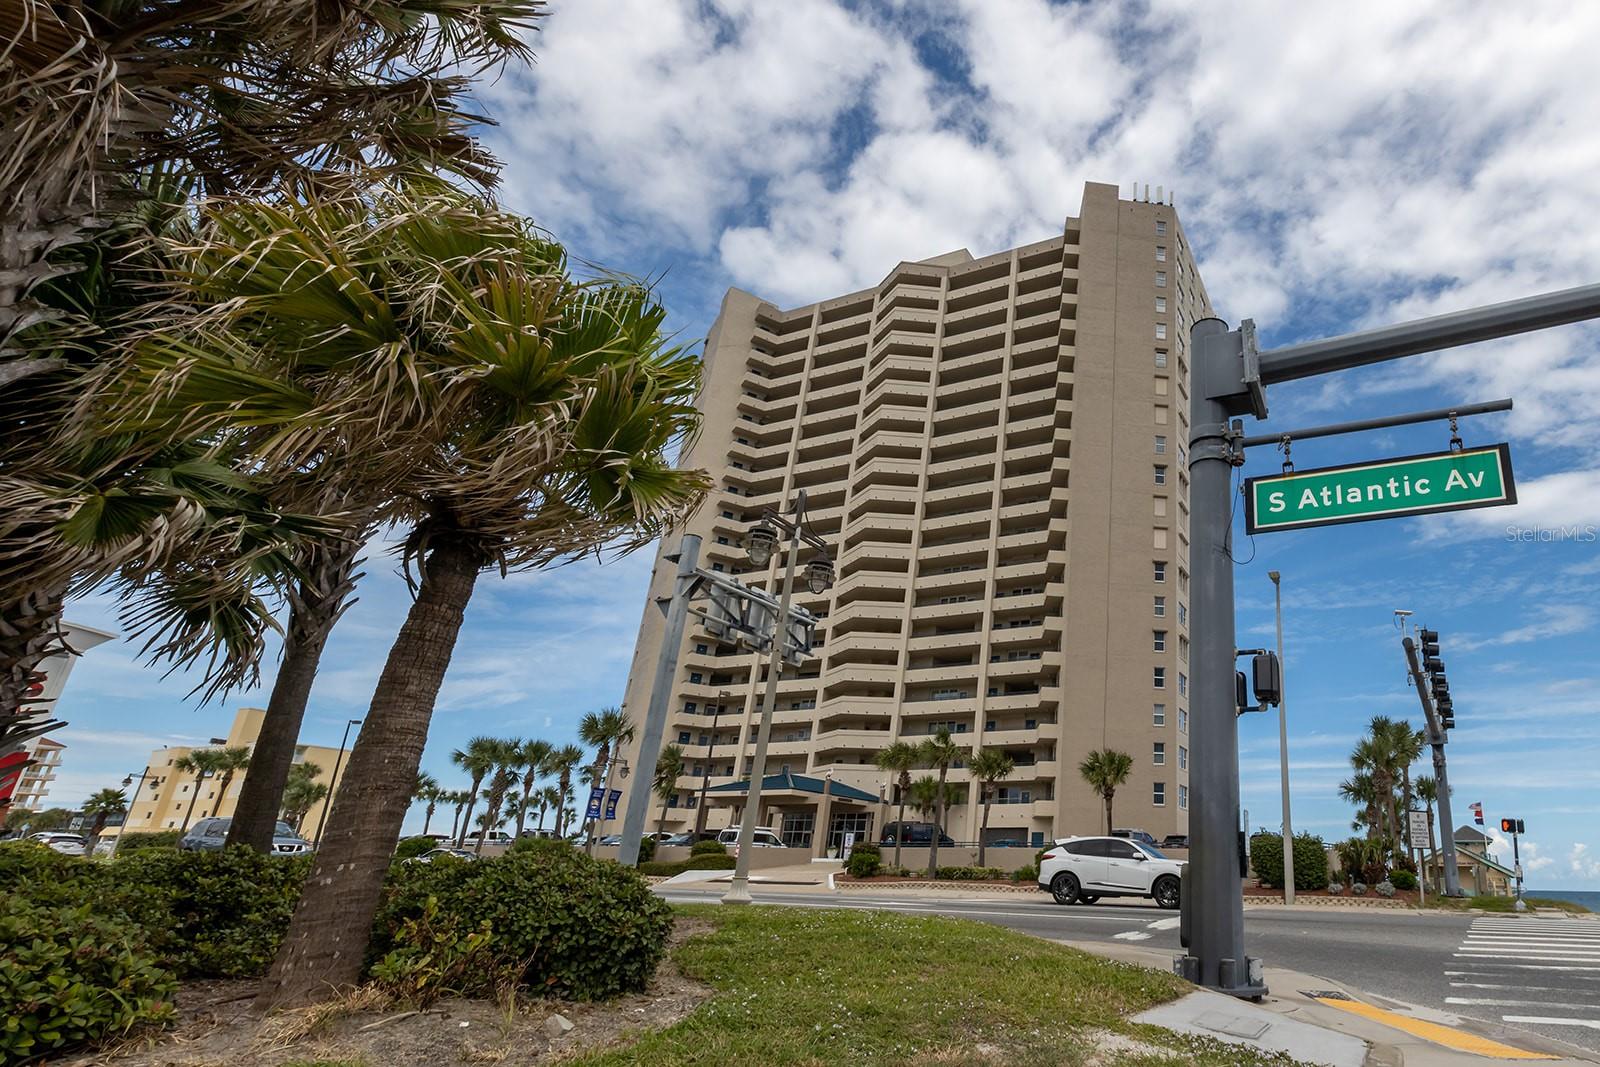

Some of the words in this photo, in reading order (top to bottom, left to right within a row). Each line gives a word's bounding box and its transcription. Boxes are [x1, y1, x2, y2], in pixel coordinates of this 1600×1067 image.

[1268, 491, 1286, 513] S
[1297, 475, 1431, 510] Atlantic
[1444, 468, 1485, 492] Av
